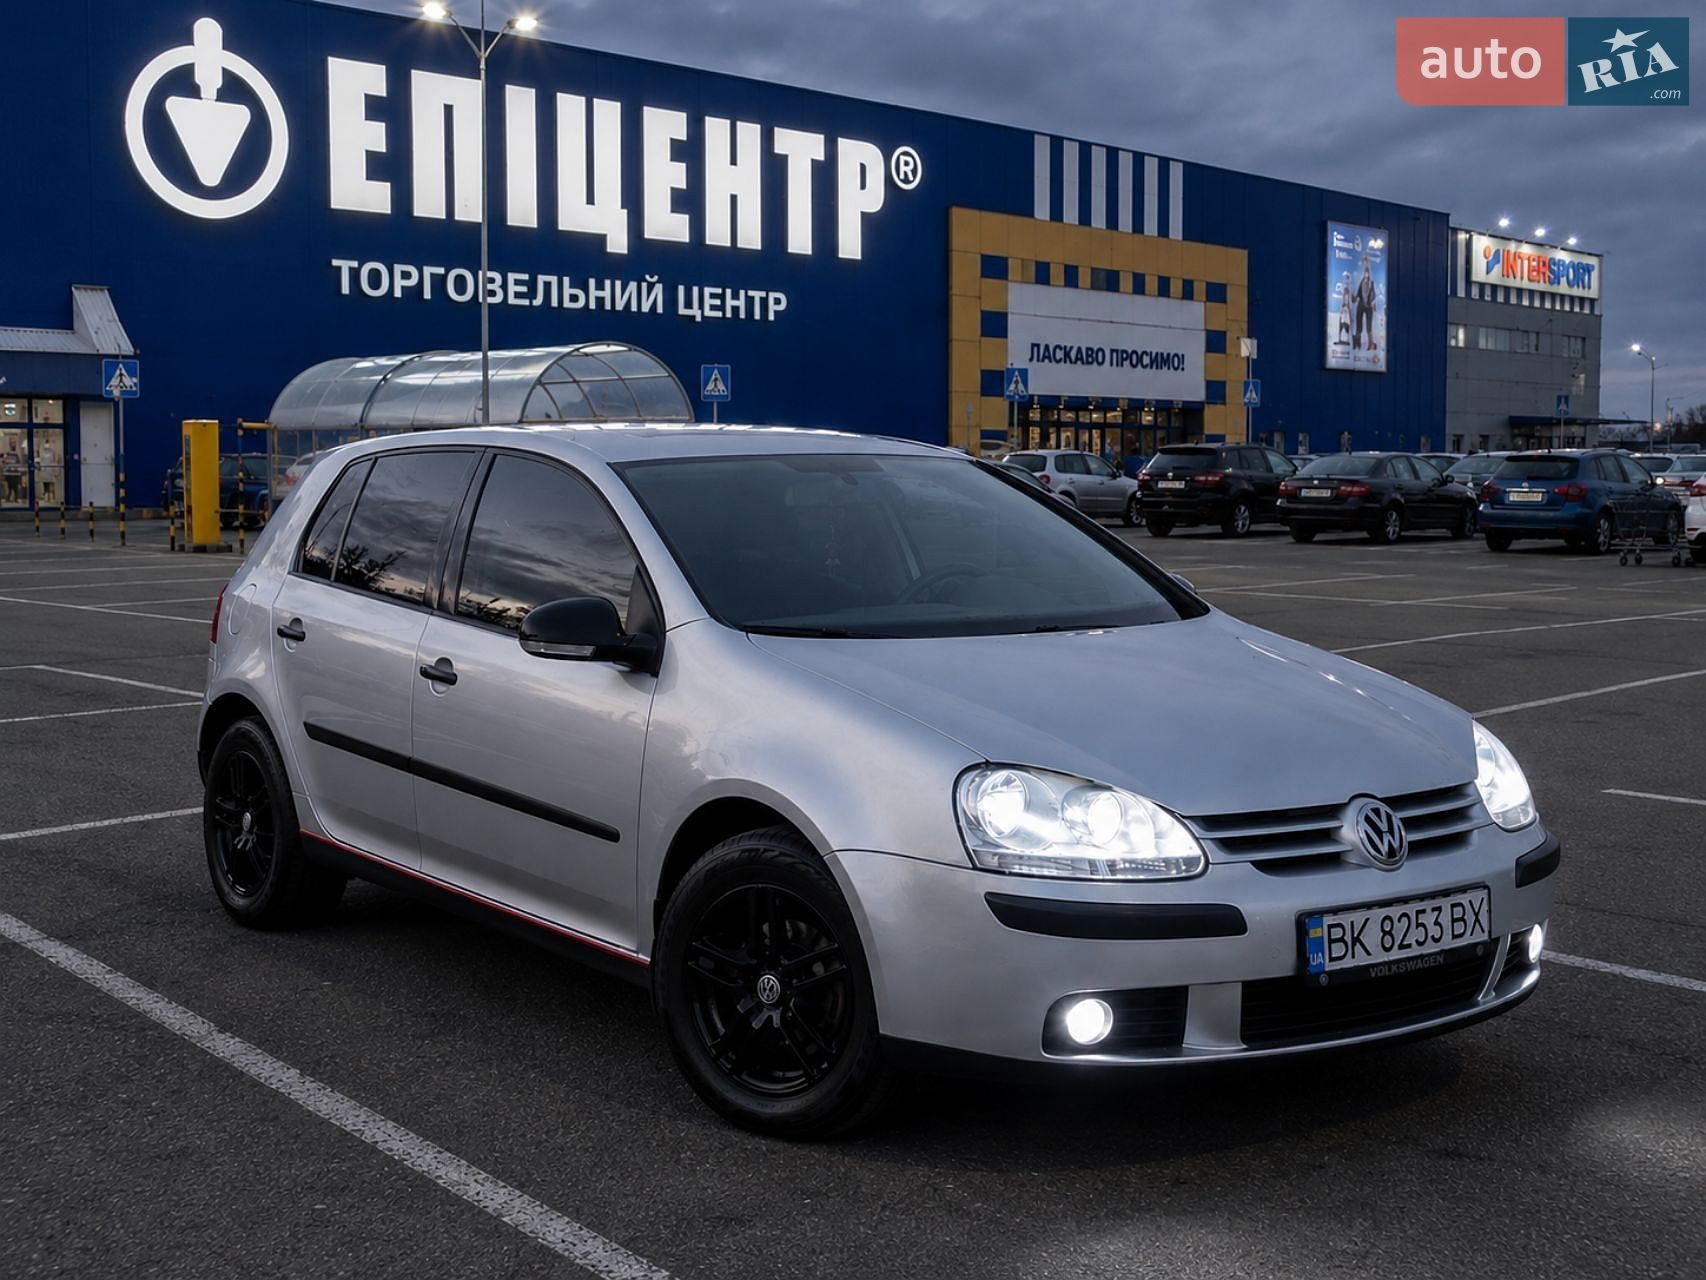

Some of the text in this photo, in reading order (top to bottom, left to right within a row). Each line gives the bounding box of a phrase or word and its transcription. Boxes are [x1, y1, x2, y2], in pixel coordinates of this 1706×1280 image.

[1502, 248, 1595, 289] INTERSPORT
[331, 258, 788, 321] ТОРГОВЕЛЬНИЙ ЦЕНТР
[1029, 342, 1185, 371] ЛАСКАВО ПРОСИМО!
[1380, 906, 1443, 953] 8253
[1310, 953, 1324, 966] UA
[1369, 954, 1444, 978] VOLKSWAGEN
